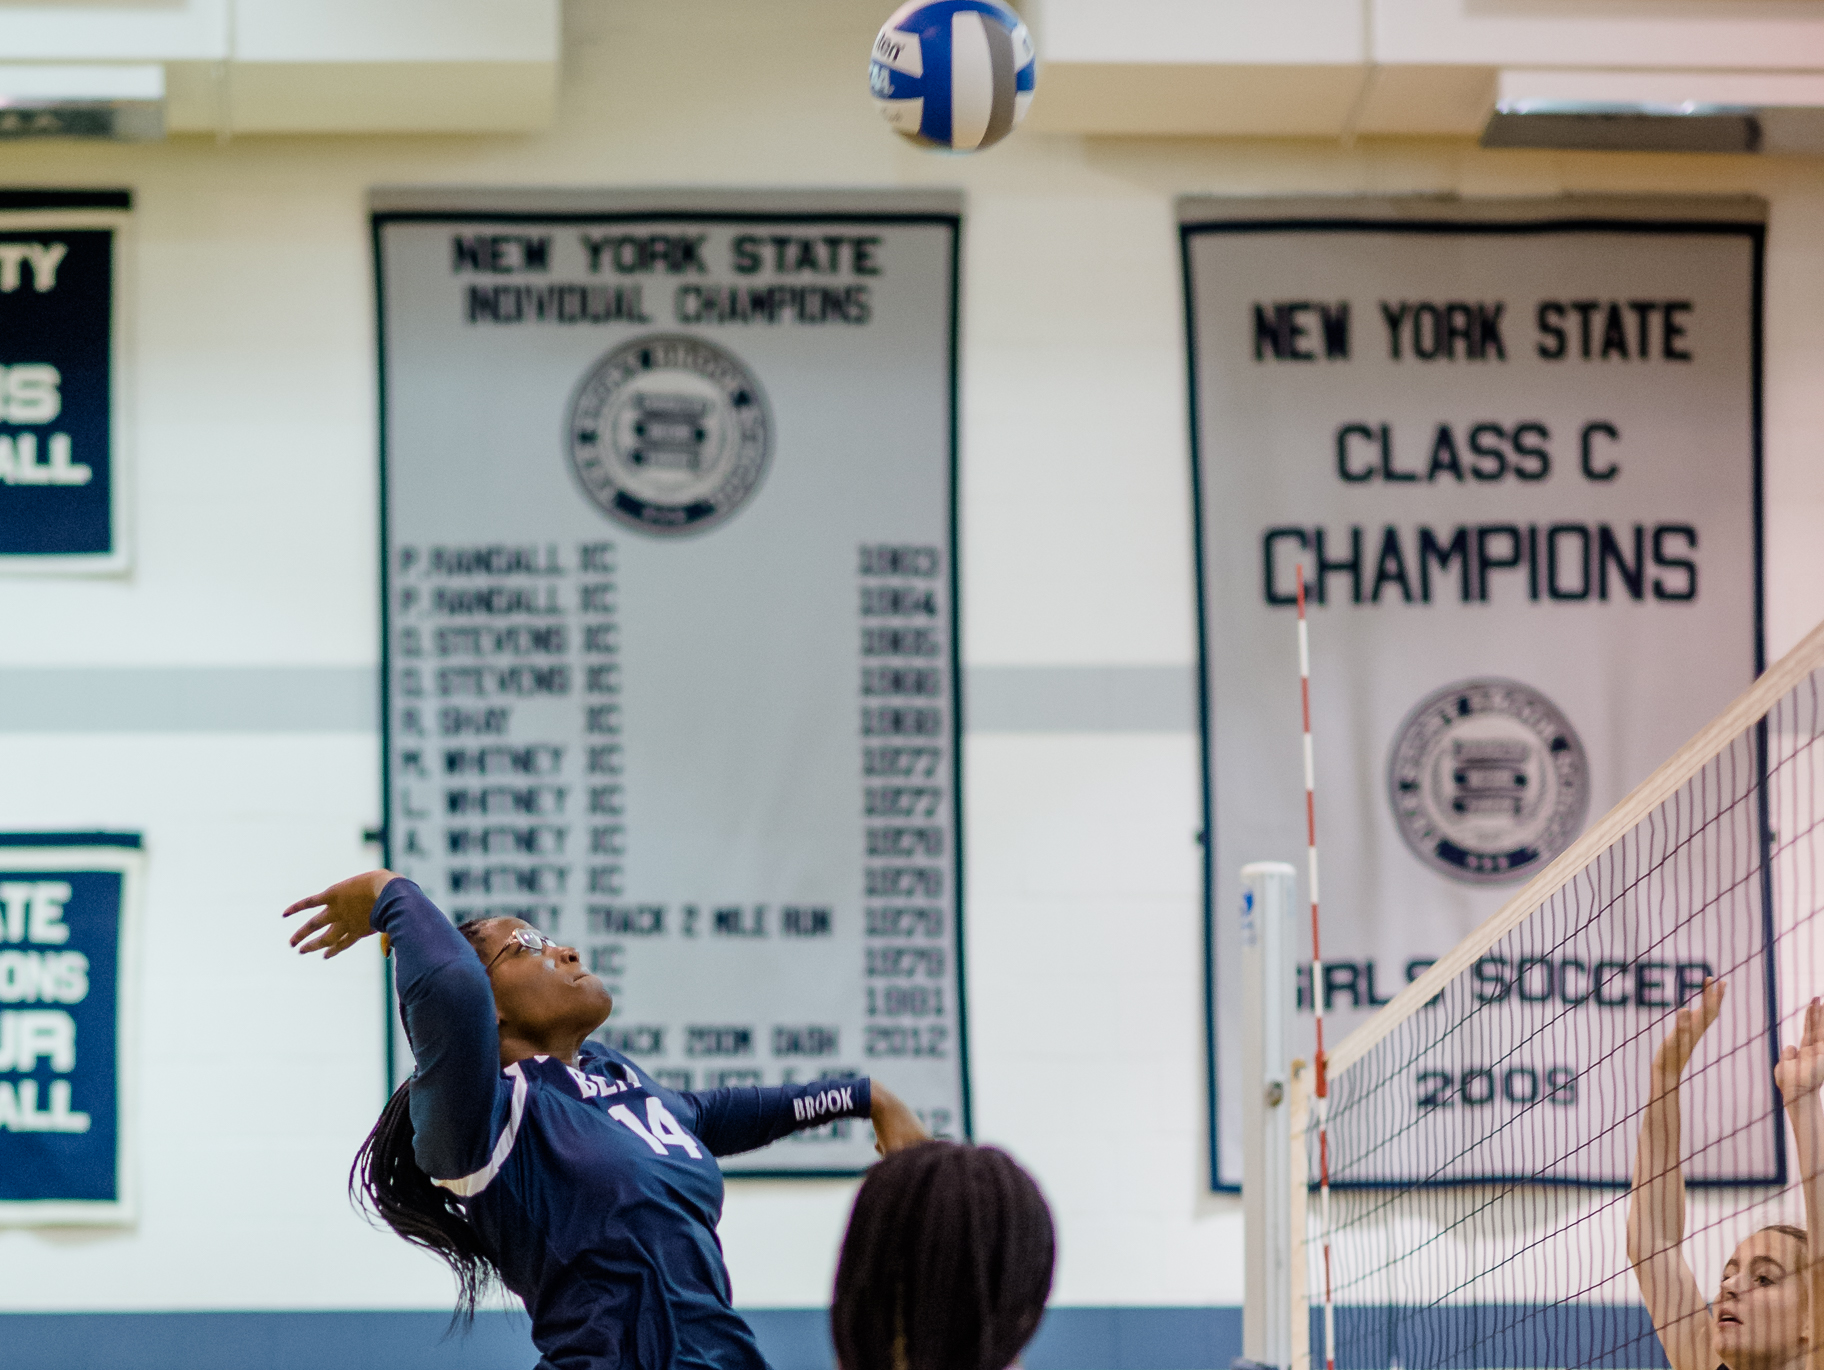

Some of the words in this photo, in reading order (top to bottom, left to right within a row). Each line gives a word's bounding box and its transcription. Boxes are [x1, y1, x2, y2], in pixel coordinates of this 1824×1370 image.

[451, 234, 552, 275] NEW
[580, 233, 708, 275] YORK
[731, 233, 883, 276] STATE
[464, 283, 652, 325] INDIVIDUAL
[676, 284, 871, 325] CHAMPIONS
[1252, 300, 1352, 362] NEW
[1380, 300, 1508, 362] YORK
[1536, 298, 1694, 362] STATE
[1335, 420, 1552, 484] CLASS
[1579, 420, 1621, 484] C
[1262, 522, 1699, 607] CHAMPIONS
[443, 746, 563, 776] WHITNEY
[445, 786, 567, 816] WHITNEY
[446, 825, 567, 855] WHITNEY
[447, 865, 568, 895] WHITNEY
[587, 905, 665, 936] TRACK
[681, 904, 700, 937] 2
[713, 906, 766, 937] MILE
[782, 906, 832, 937] RUN
[1474, 957, 1713, 1008] SOCCER
[864, 1024, 949, 1059] 2012
[793, 1087, 853, 1121] BROOK
[607, 1096, 703, 1159] 14
